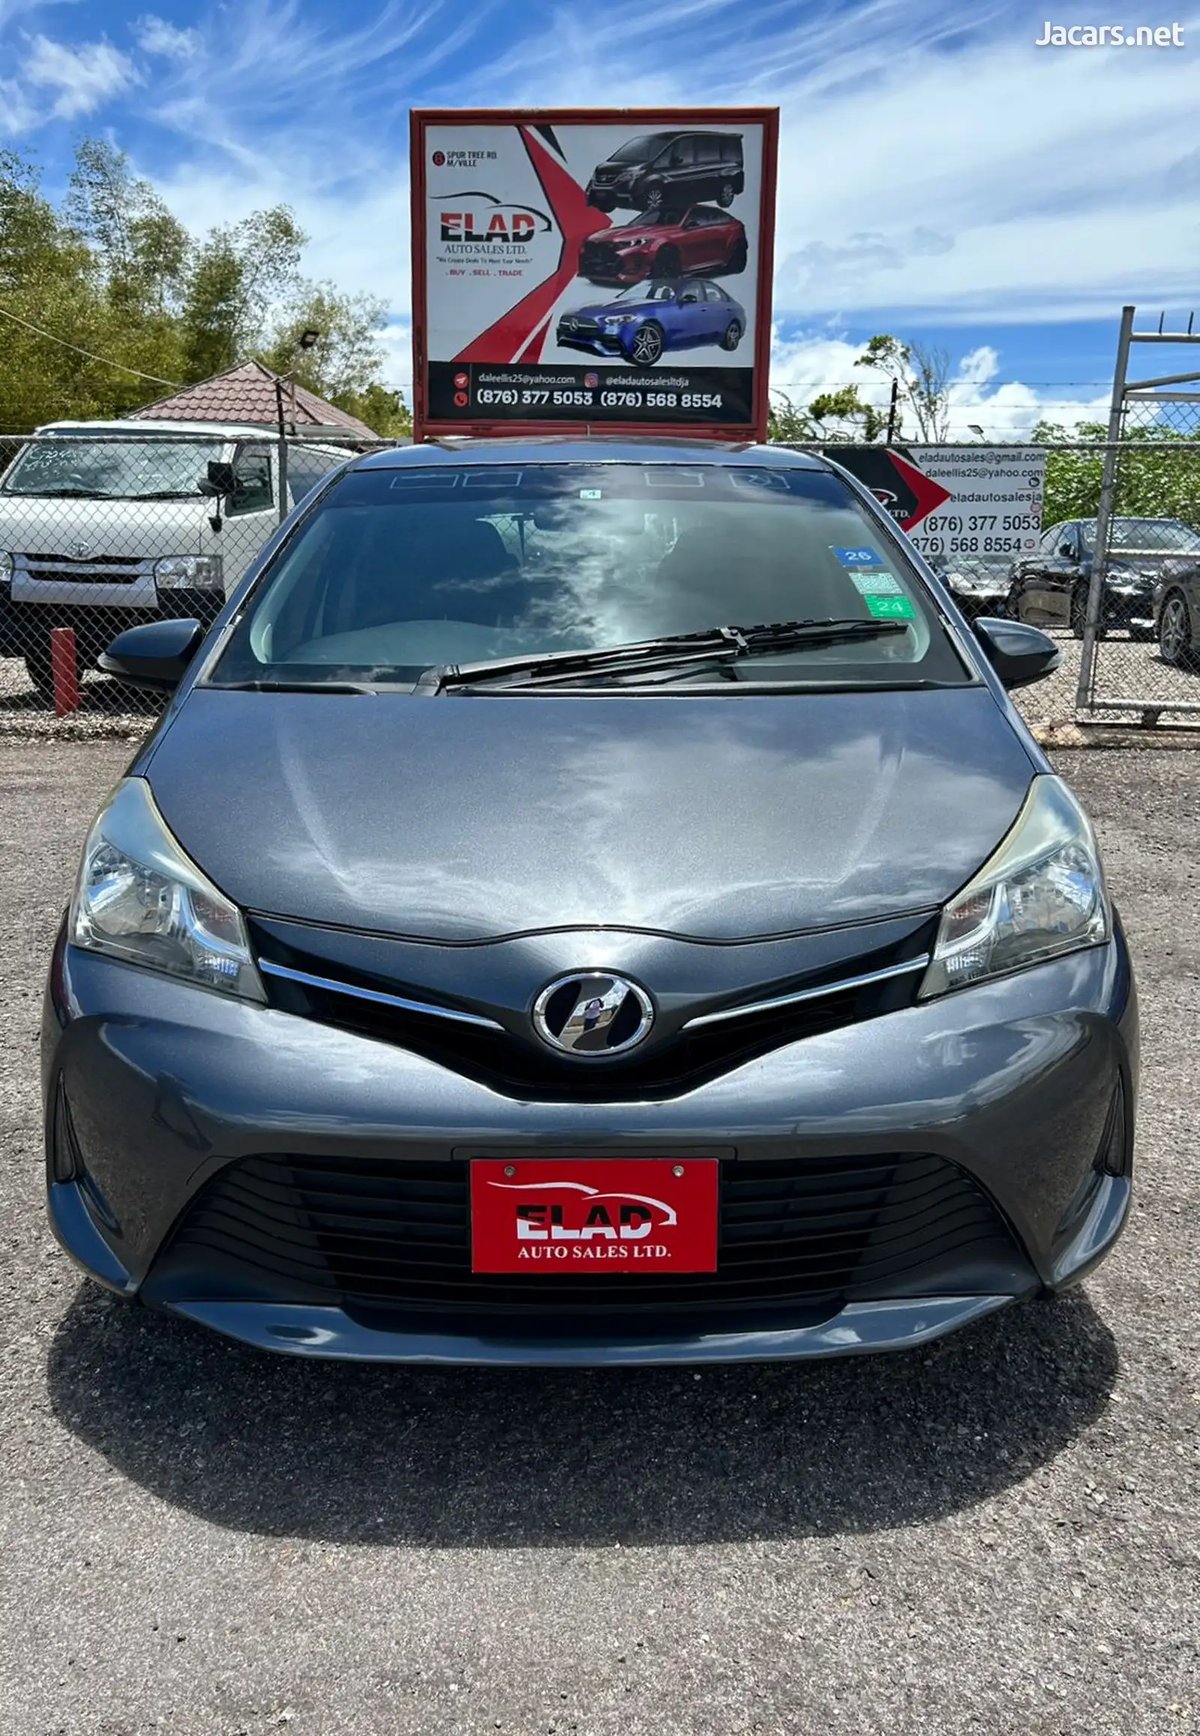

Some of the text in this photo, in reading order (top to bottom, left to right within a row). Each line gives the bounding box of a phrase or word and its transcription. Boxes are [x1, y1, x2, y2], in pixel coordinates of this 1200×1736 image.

[446, 150, 467, 159] SPUR
[467, 151, 485, 159] TREE
[441, 212, 535, 243] ELAD
[445, 244, 527, 255] AUTO SALES LTD.
[477, 388, 593, 405] (876) 377 5053
[600, 391, 723, 408] (876) 568 8554
[918, 452, 1045, 465] eladautosales@gmail.com
[925, 467, 1044, 478] daleellis25@yahoo.com
[923, 515, 1041, 535] (876) 377 5053
[950, 537, 979, 552] 568
[983, 537, 1022, 552] 8554
[845, 551, 872, 560] 26
[876, 601, 903, 612] 24
[516, 1205, 652, 1240] ELAD
[517, 1246, 672, 1259] AUTO SALES LTD.
